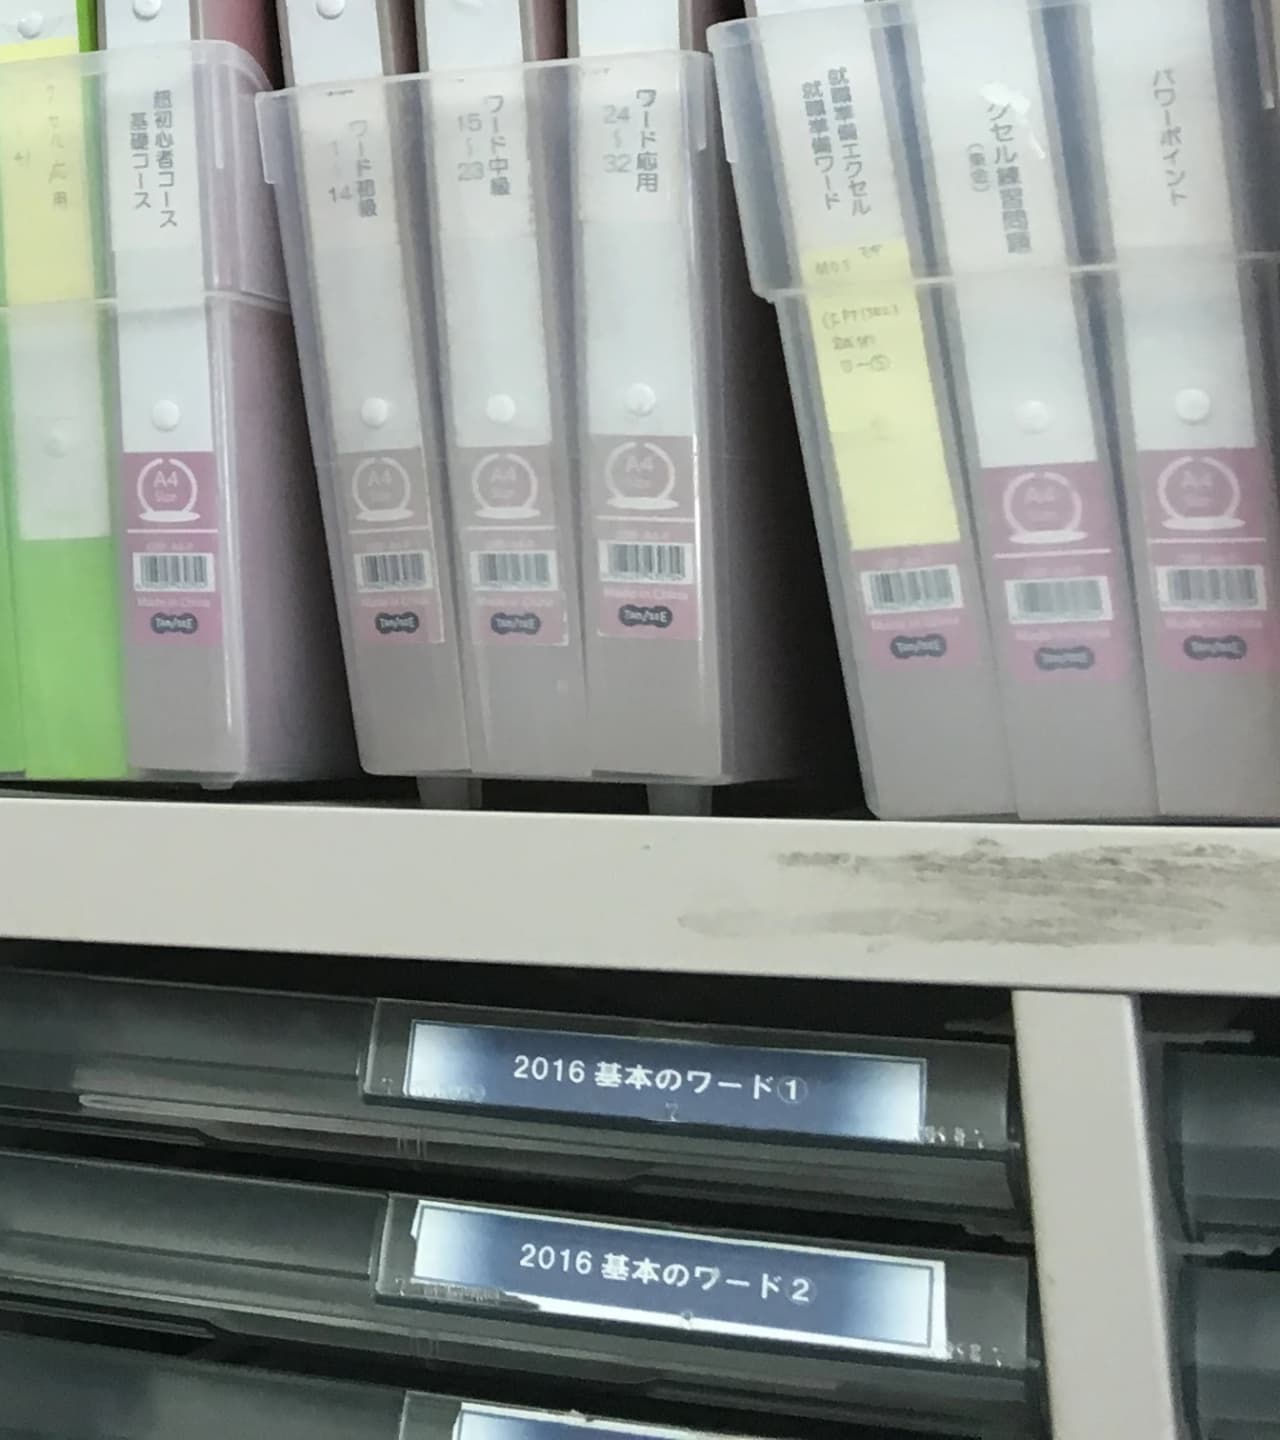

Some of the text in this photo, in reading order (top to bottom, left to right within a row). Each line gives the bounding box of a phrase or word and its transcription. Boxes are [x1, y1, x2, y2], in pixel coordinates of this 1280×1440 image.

[1153, 68, 1188, 207] パワーポイント
[513, 1054, 586, 1084] 2016
[519, 1243, 593, 1275] 2016
